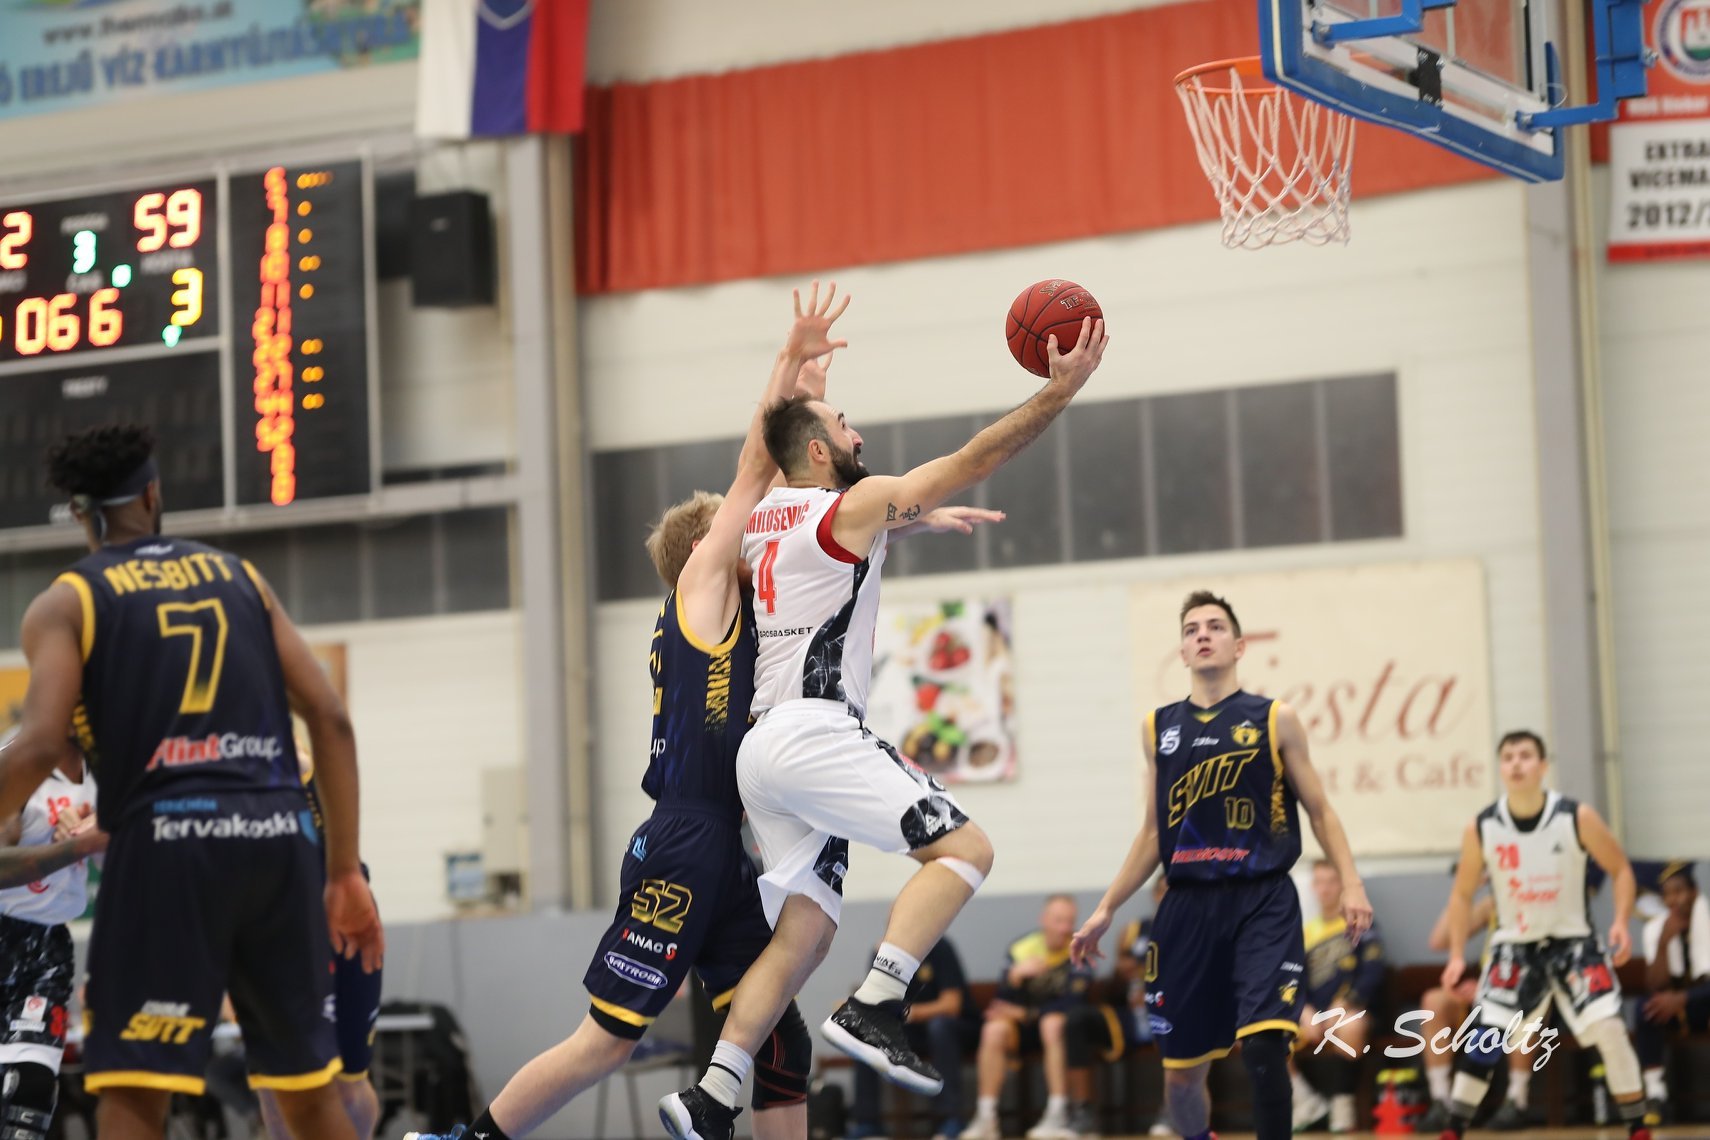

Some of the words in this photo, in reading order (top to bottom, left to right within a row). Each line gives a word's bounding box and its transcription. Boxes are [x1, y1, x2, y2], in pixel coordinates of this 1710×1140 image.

[133, 188, 201, 252] 59
[170, 267, 203, 327] 3
[104, 553, 234, 595] NESBITT
[758, 539, 781, 615] 4
[156, 597, 228, 715] 7
[1156, 629, 1476, 745] iesta
[1168, 748, 1260, 829] SVIT
[1396, 752, 1485, 790] Cafe
[152, 811, 299, 842] Tervakoski
[1224, 796, 1256, 830] 10
[631, 879, 692, 935] 52
